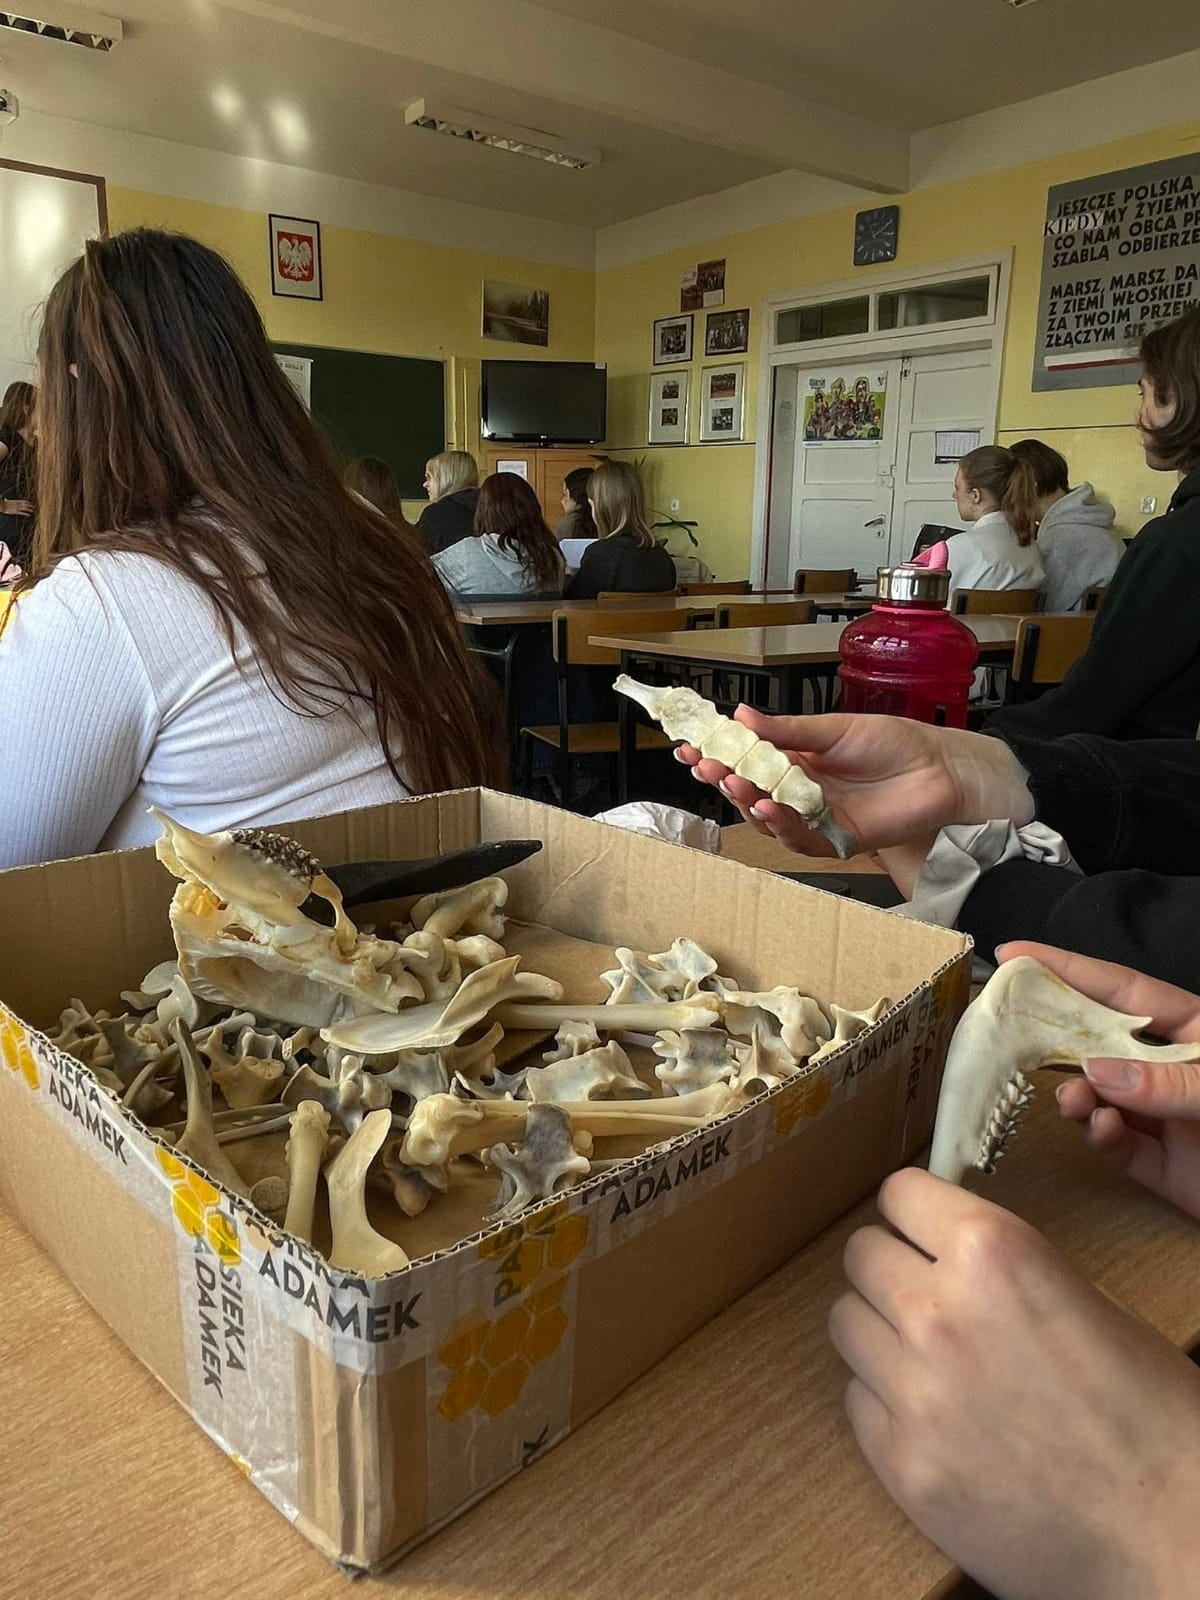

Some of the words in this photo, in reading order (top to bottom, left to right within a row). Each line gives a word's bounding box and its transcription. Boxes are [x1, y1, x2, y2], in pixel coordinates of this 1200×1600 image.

[1057, 192, 1116, 218] JESZCZE
[1124, 175, 1193, 204] POLSKA
[1054, 234, 1076, 251] CO
[1082, 225, 1120, 246] NAM
[1129, 215, 1177, 237] OBCA
[1048, 301, 1058, 316] Z
[1063, 294, 1104, 315] ZIEMI
[1112, 281, 1192, 307] WŁOSKIEJ
[1049, 278, 1105, 299] MARSZ,
[1045, 326, 1115, 348] ZŁĄCZYM
[1047, 316, 1067, 332] ZA
[1074, 307, 1130, 328] TWOIM
[842, 1010, 912, 1084] ADAMEK
[50, 1073, 127, 1166] ADAMEK
[609, 1128, 733, 1224] ADAMEK
[193, 1227, 224, 1399] ADAMEK
[258, 1249, 424, 1344] ADAMEK
